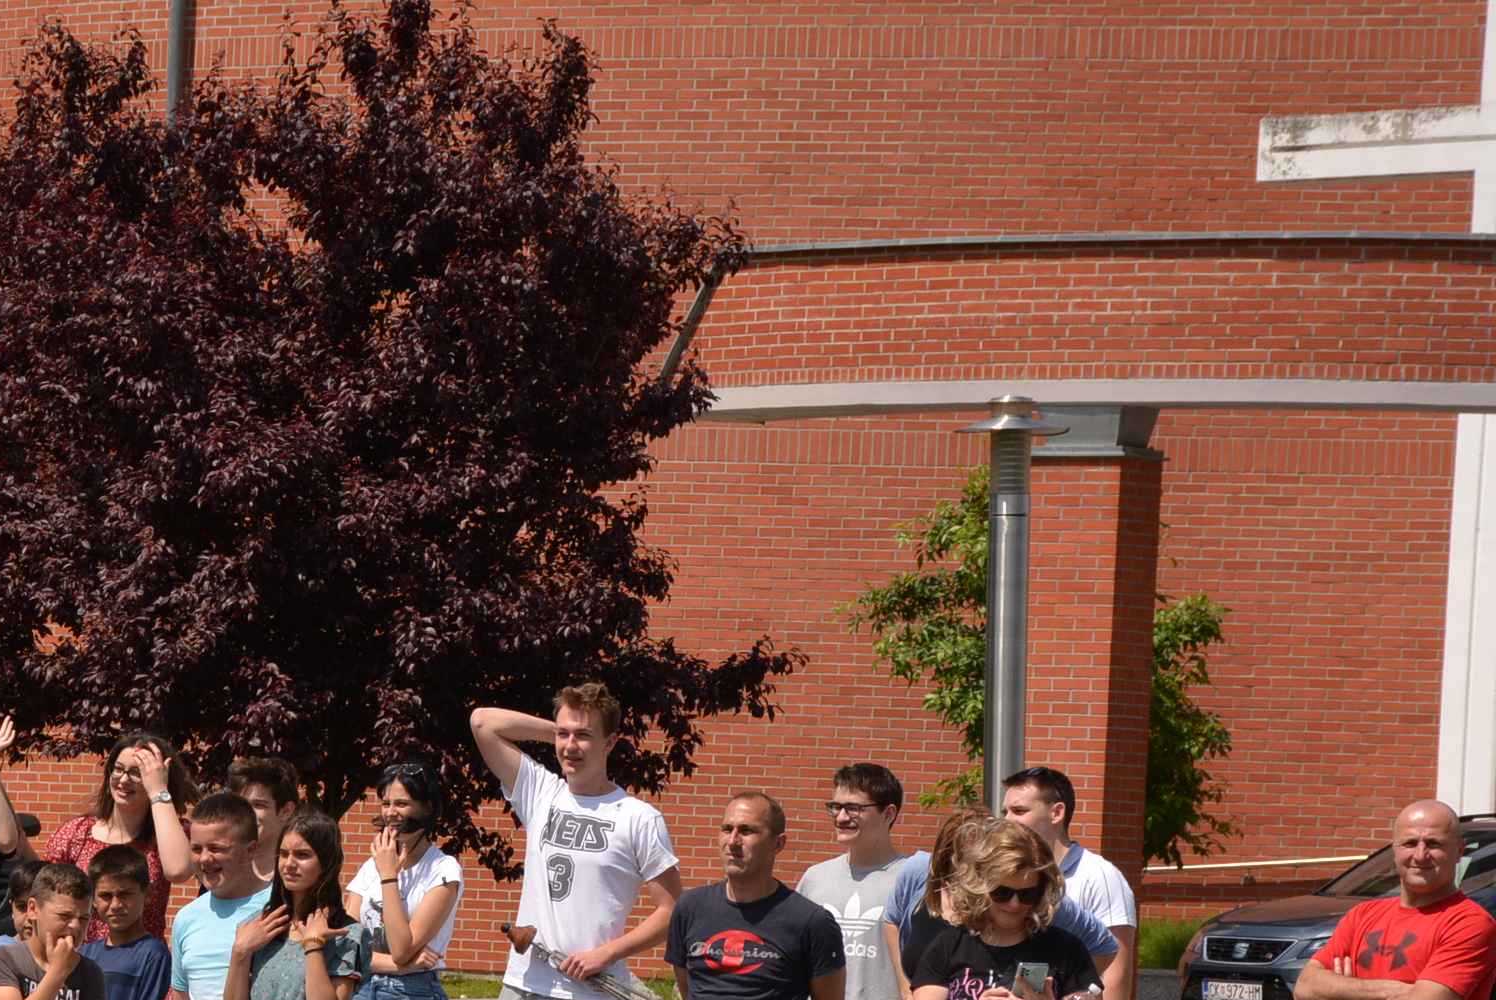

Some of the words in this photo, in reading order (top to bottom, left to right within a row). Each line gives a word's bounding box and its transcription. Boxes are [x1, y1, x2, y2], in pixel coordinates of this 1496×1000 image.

[540, 807, 616, 853] NETS
[546, 853, 575, 902] 3
[844, 939, 878, 959] das
